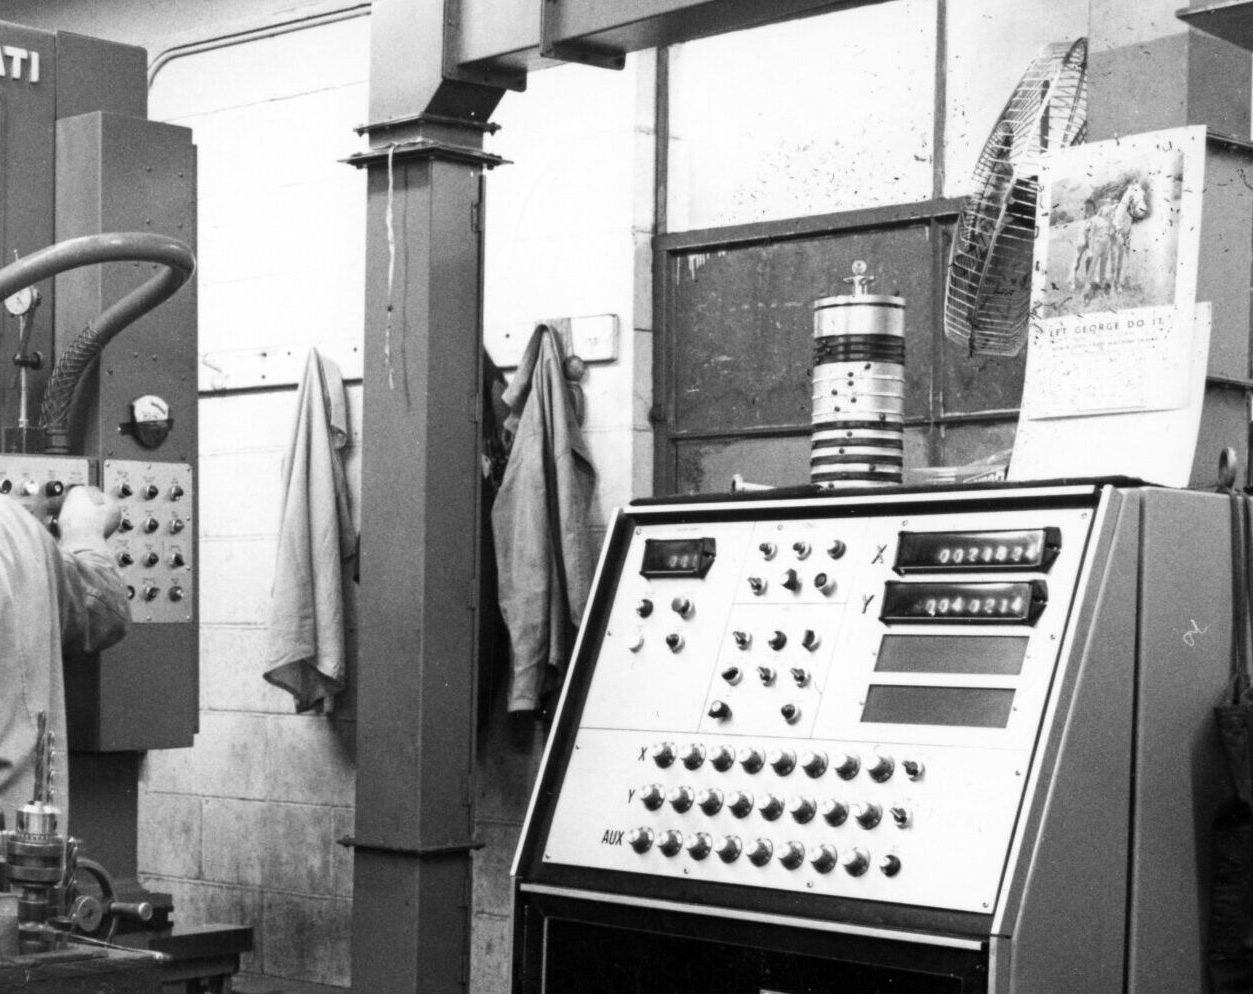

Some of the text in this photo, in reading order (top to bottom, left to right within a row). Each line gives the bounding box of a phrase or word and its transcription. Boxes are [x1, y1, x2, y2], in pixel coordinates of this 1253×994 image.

[1074, 321, 1119, 335] GEORGE
[1127, 319, 1145, 329] DO
[871, 544, 888, 565] X
[861, 593, 875, 614] Y
[637, 746, 648, 762] X
[627, 788, 637, 804] Y
[601, 828, 625, 846] AUX
